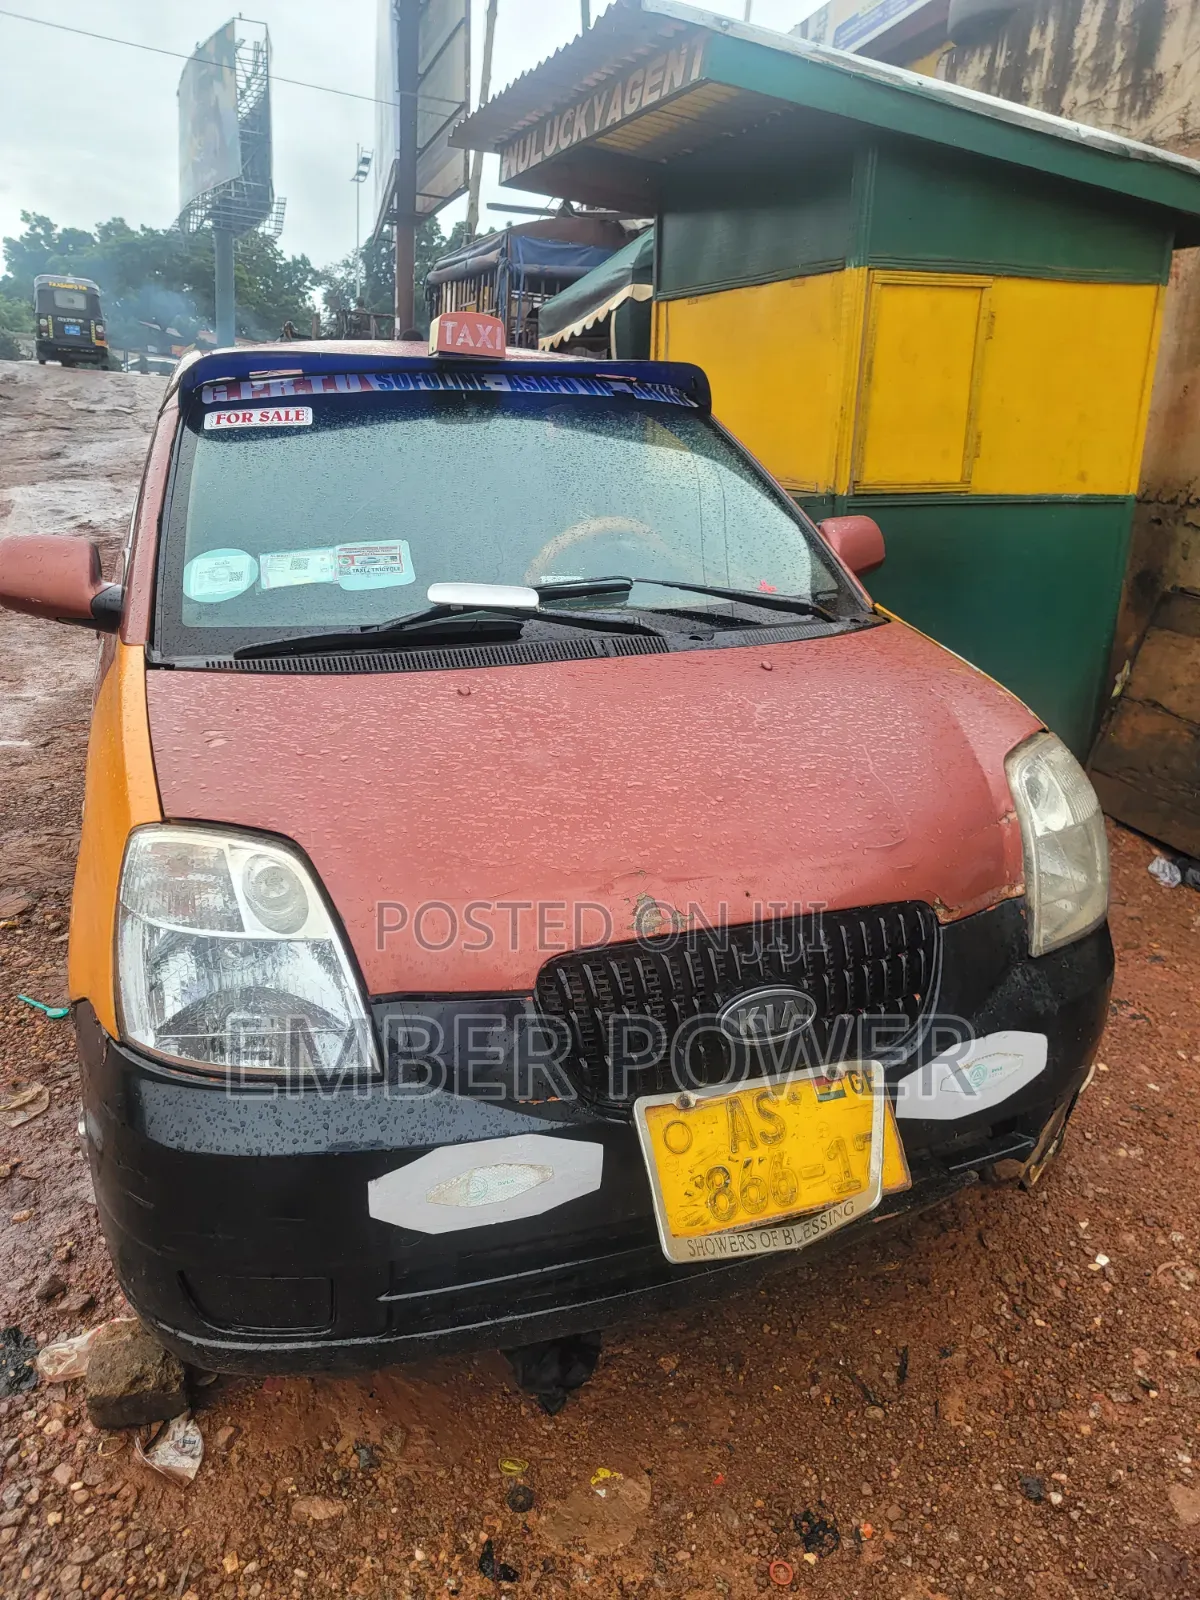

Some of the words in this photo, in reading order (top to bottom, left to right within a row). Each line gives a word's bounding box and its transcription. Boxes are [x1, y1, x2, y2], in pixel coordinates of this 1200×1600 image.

[441, 320, 502, 350] TAXI
[374, 373, 492, 391] SOFOLINE
[509, 375, 580, 394] ASAFO
[579, 378, 615, 397] VIP
[215, 412, 254, 425] FOR
[259, 409, 305, 422] SALE
[737, 999, 804, 1036] KIA
[726, 1091, 787, 1154] AS
[687, 1234, 756, 1257] SHOWERS
[760, 1229, 779, 1248] OF
[784, 1201, 855, 1246] BLESSING
